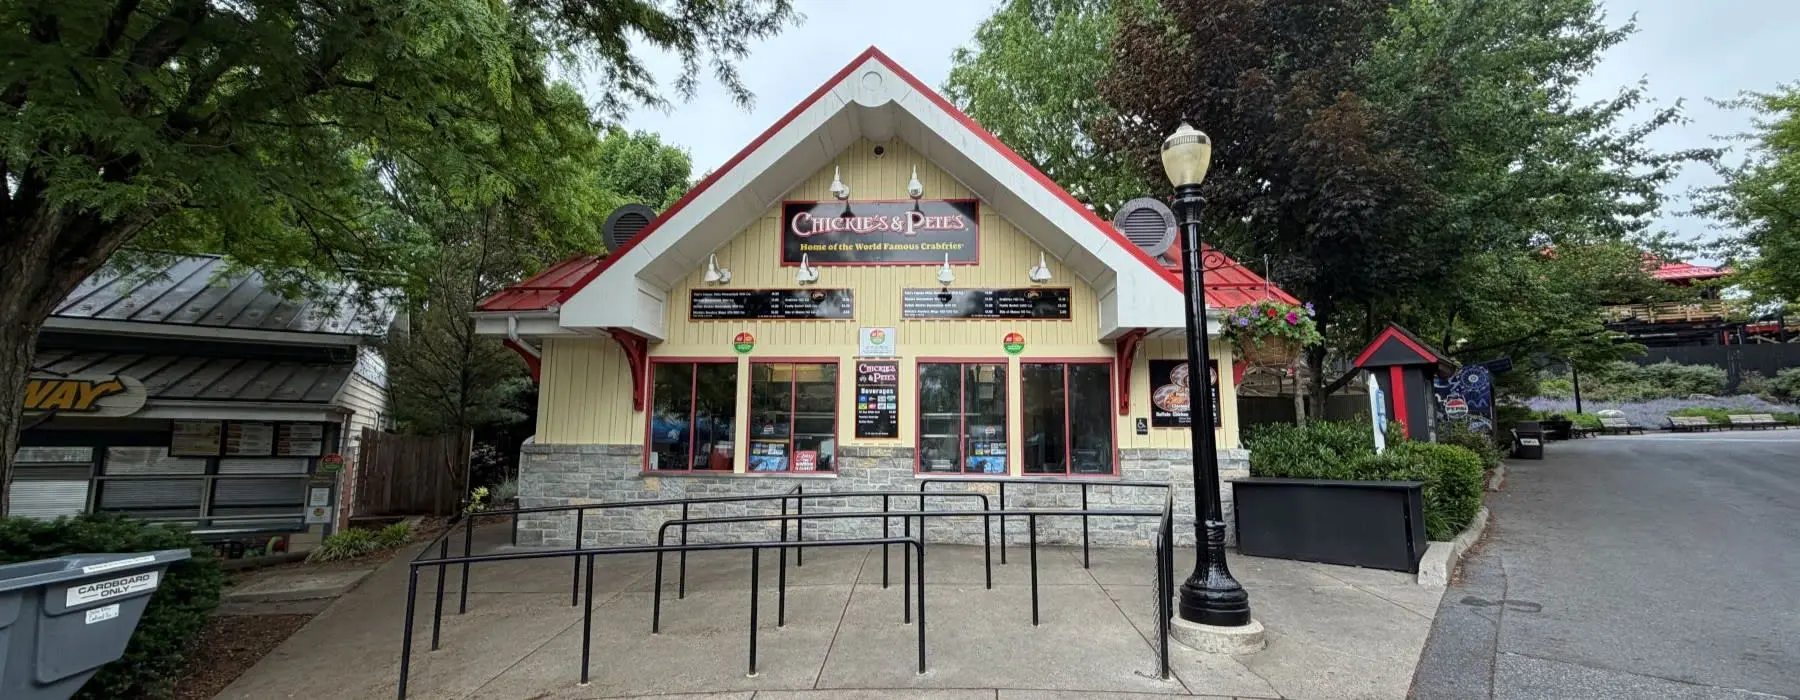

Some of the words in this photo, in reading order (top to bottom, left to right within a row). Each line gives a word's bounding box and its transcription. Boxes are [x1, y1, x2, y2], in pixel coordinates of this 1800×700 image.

[791, 211, 889, 237] CHICKIE'S
[890, 217, 904, 232] &
[904, 210, 965, 236] PETE'S
[800, 243, 827, 251] Home
[828, 242, 838, 251] of
[838, 242, 854, 251] the
[855, 242, 882, 251] World
[883, 242, 919, 251] Famous
[920, 241, 962, 251] Crabfries
[859, 363, 896, 374] CHICKIE'S
[861, 387, 894, 395] Beverages
[78, 573, 150, 595] CARDBOARD
[100, 585, 130, 598] ONLY
